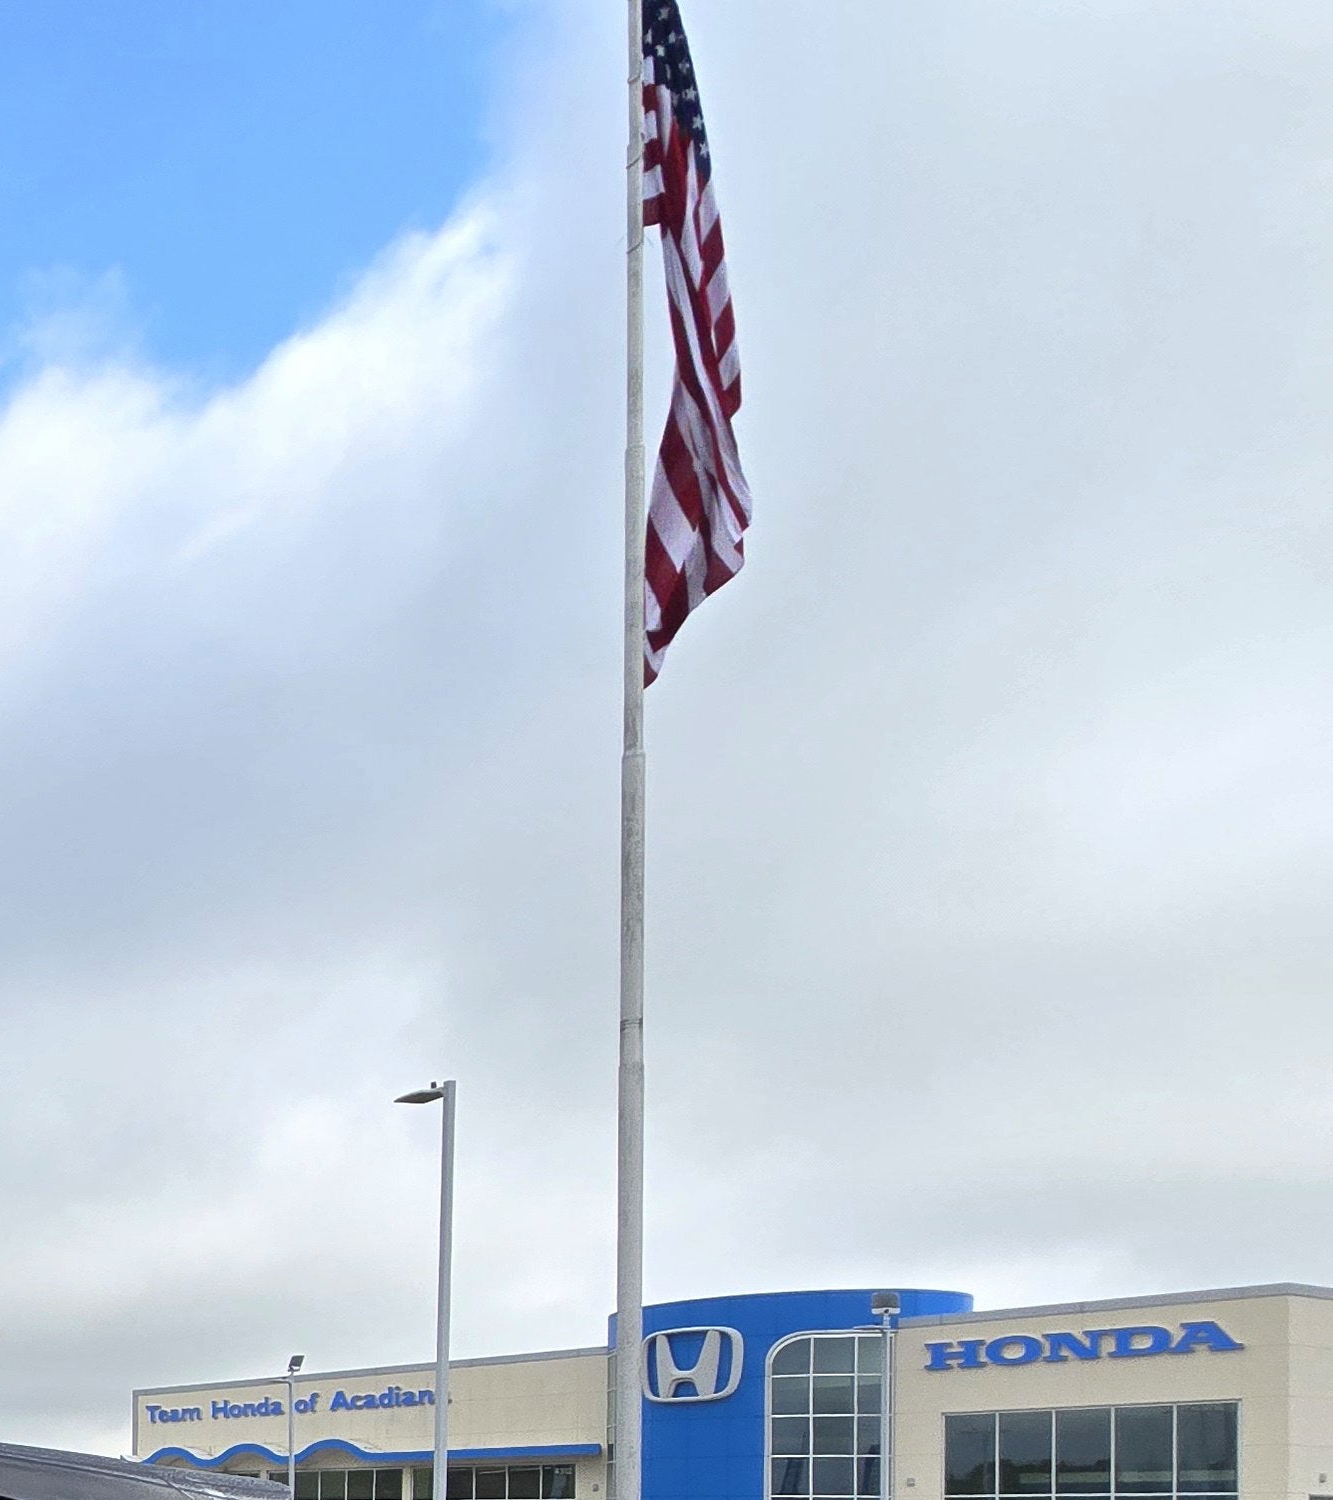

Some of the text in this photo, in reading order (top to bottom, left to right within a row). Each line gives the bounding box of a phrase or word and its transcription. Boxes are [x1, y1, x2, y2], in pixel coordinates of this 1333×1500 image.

[924, 1320, 1245, 1372] HONDA
[145, 1386, 452, 1424] Team Honda of Acadian
